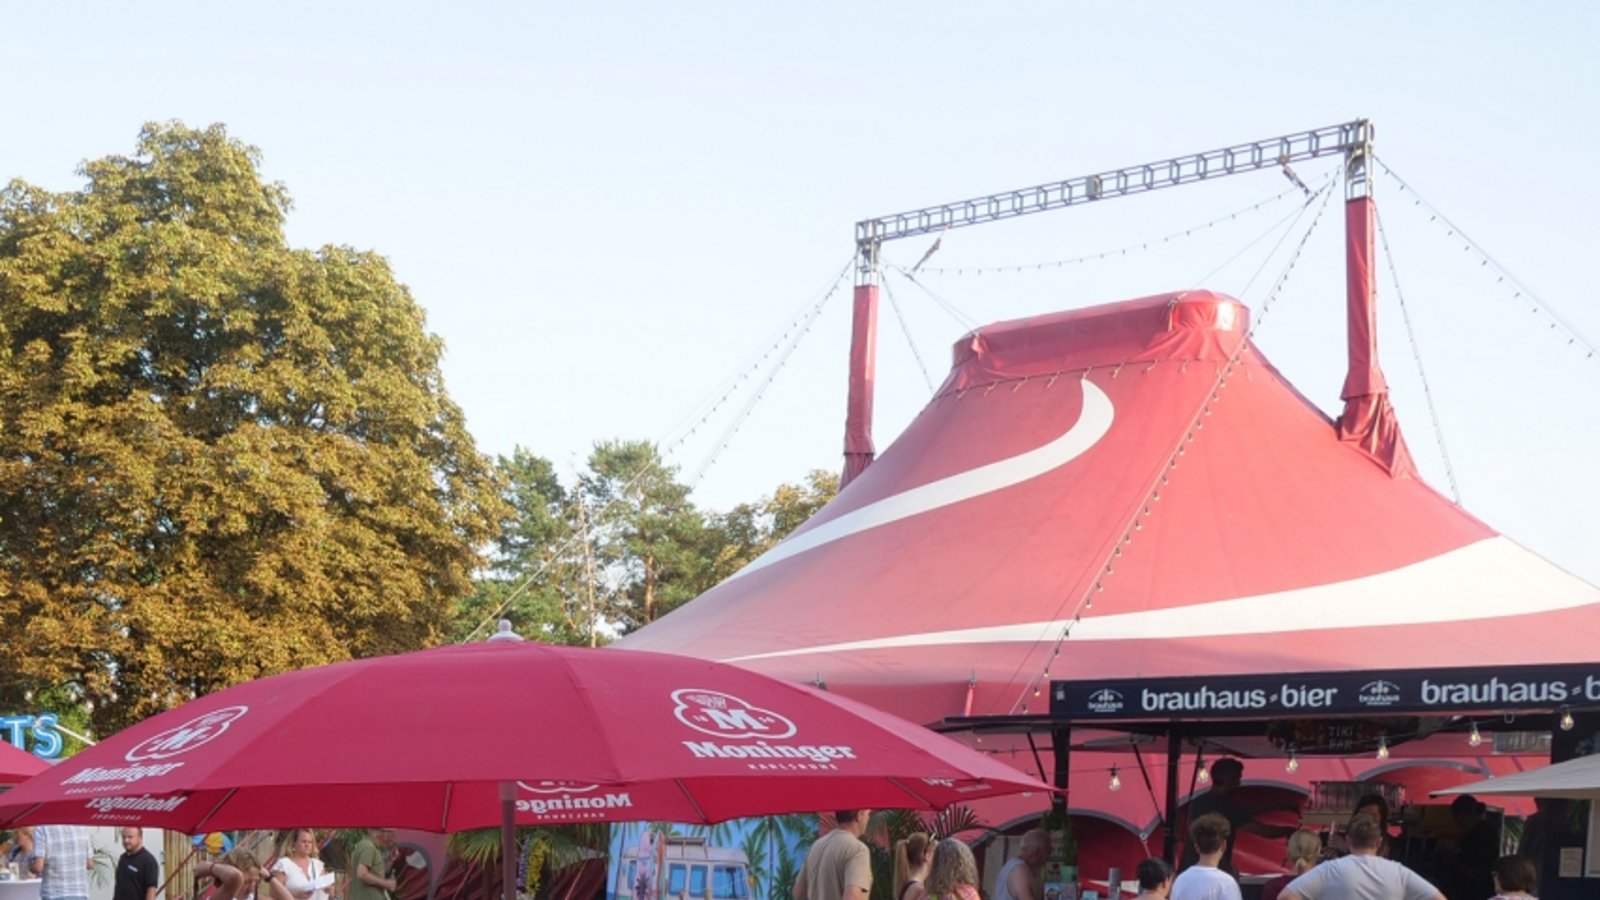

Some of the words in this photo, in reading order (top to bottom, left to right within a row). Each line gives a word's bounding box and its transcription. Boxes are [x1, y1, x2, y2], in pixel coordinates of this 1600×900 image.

[1141, 685, 1267, 711] brauhaus
[1280, 683, 1338, 708] bier
[1421, 677, 1567, 704] brauhaus
[700, 708, 769, 730] M
[0, 712, 63, 759] TS
[682, 740, 857, 762] Moninger
